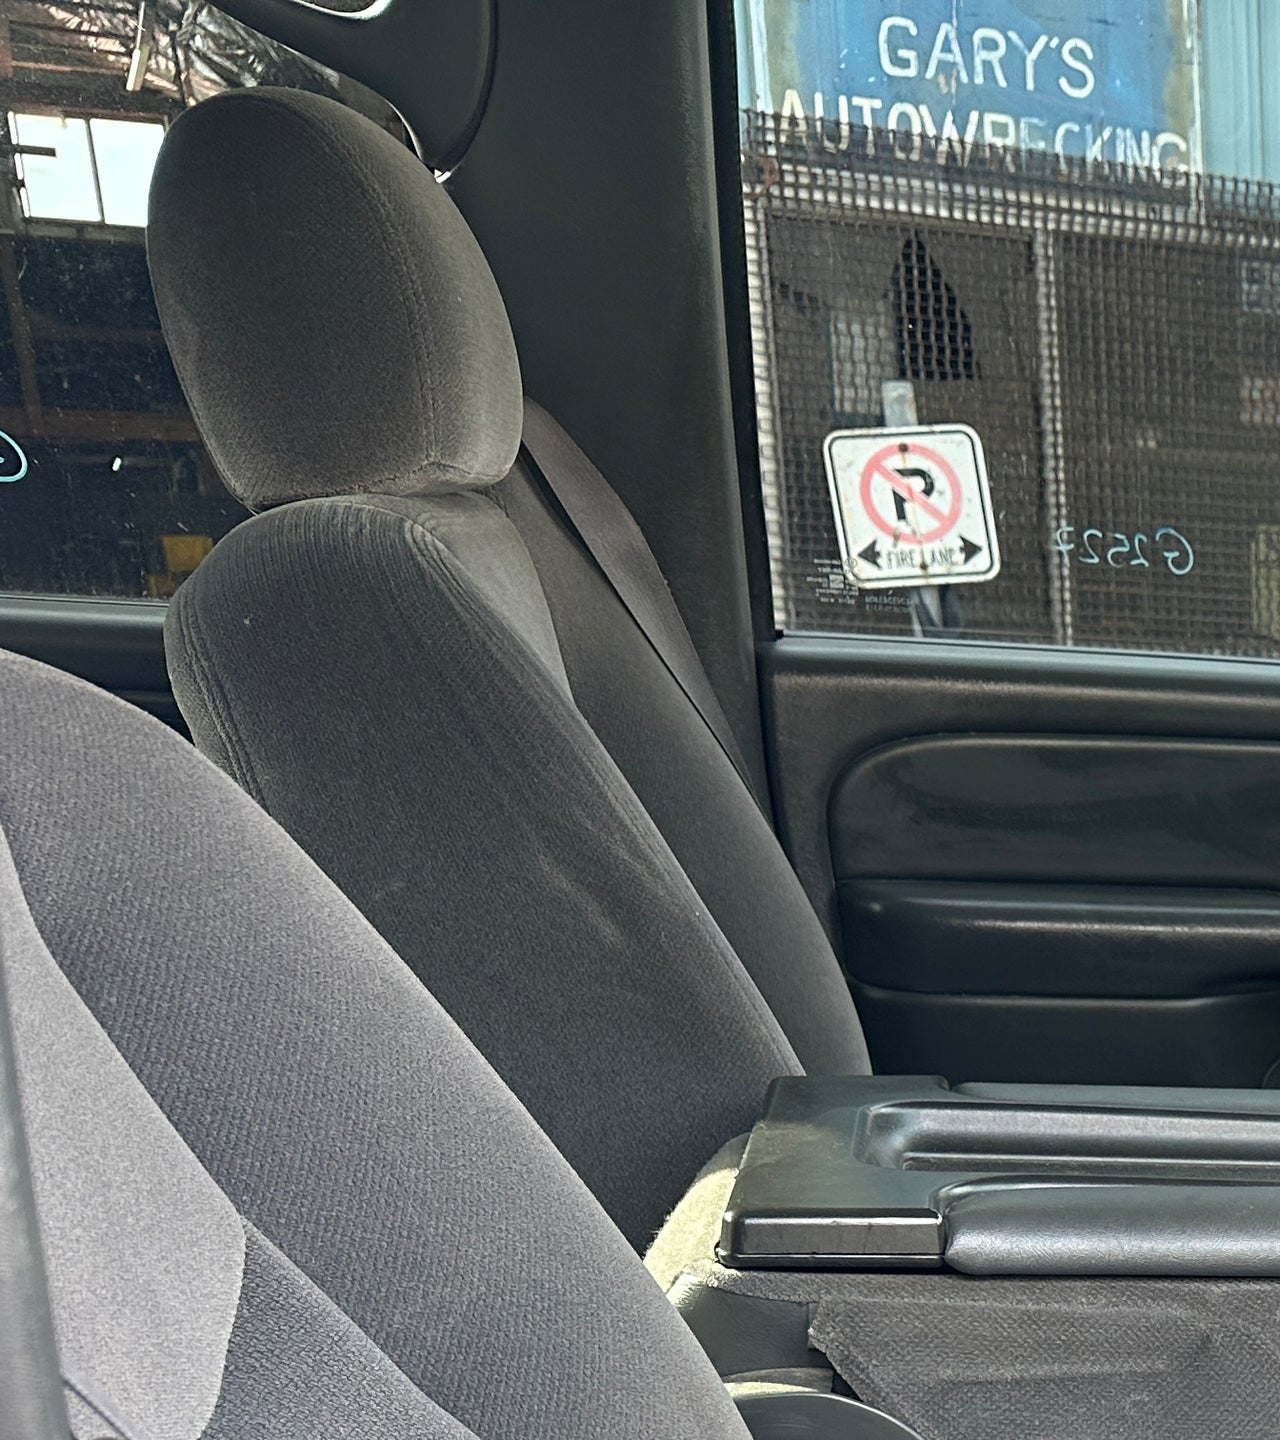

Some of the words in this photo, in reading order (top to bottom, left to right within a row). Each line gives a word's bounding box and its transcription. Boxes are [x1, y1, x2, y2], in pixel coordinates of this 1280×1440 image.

[878, 16, 1096, 98] GARY'S
[886, 550, 917, 570] FIRE
[920, 547, 957, 568] ANE
